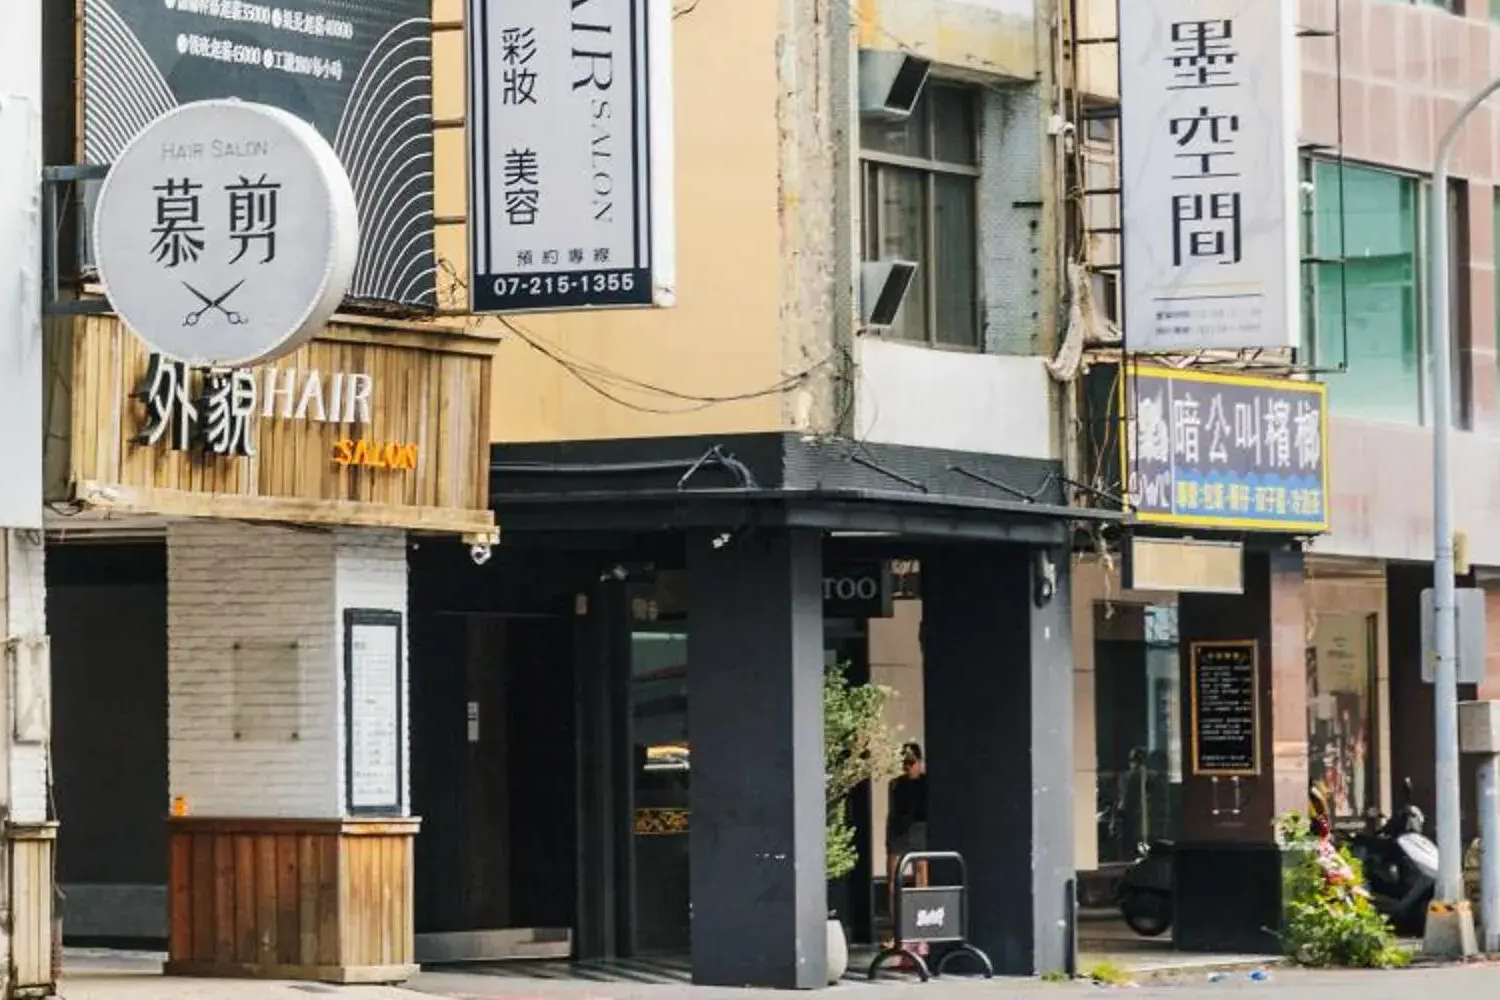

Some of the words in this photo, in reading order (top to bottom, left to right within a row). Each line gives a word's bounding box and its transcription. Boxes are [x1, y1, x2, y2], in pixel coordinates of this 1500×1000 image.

[502, 27, 538, 106] 彩妝
[211, 138, 269, 159] SALON
[503, 148, 540, 226] 美容
[591, 100, 613, 223] SALON
[150, 173, 281, 269] 慕剪
[494, 274, 634, 297] 07-215-1355
[148, 355, 256, 455] 外貌
[264, 368, 373, 424] HAIR
[334, 439, 418, 471] SALON
